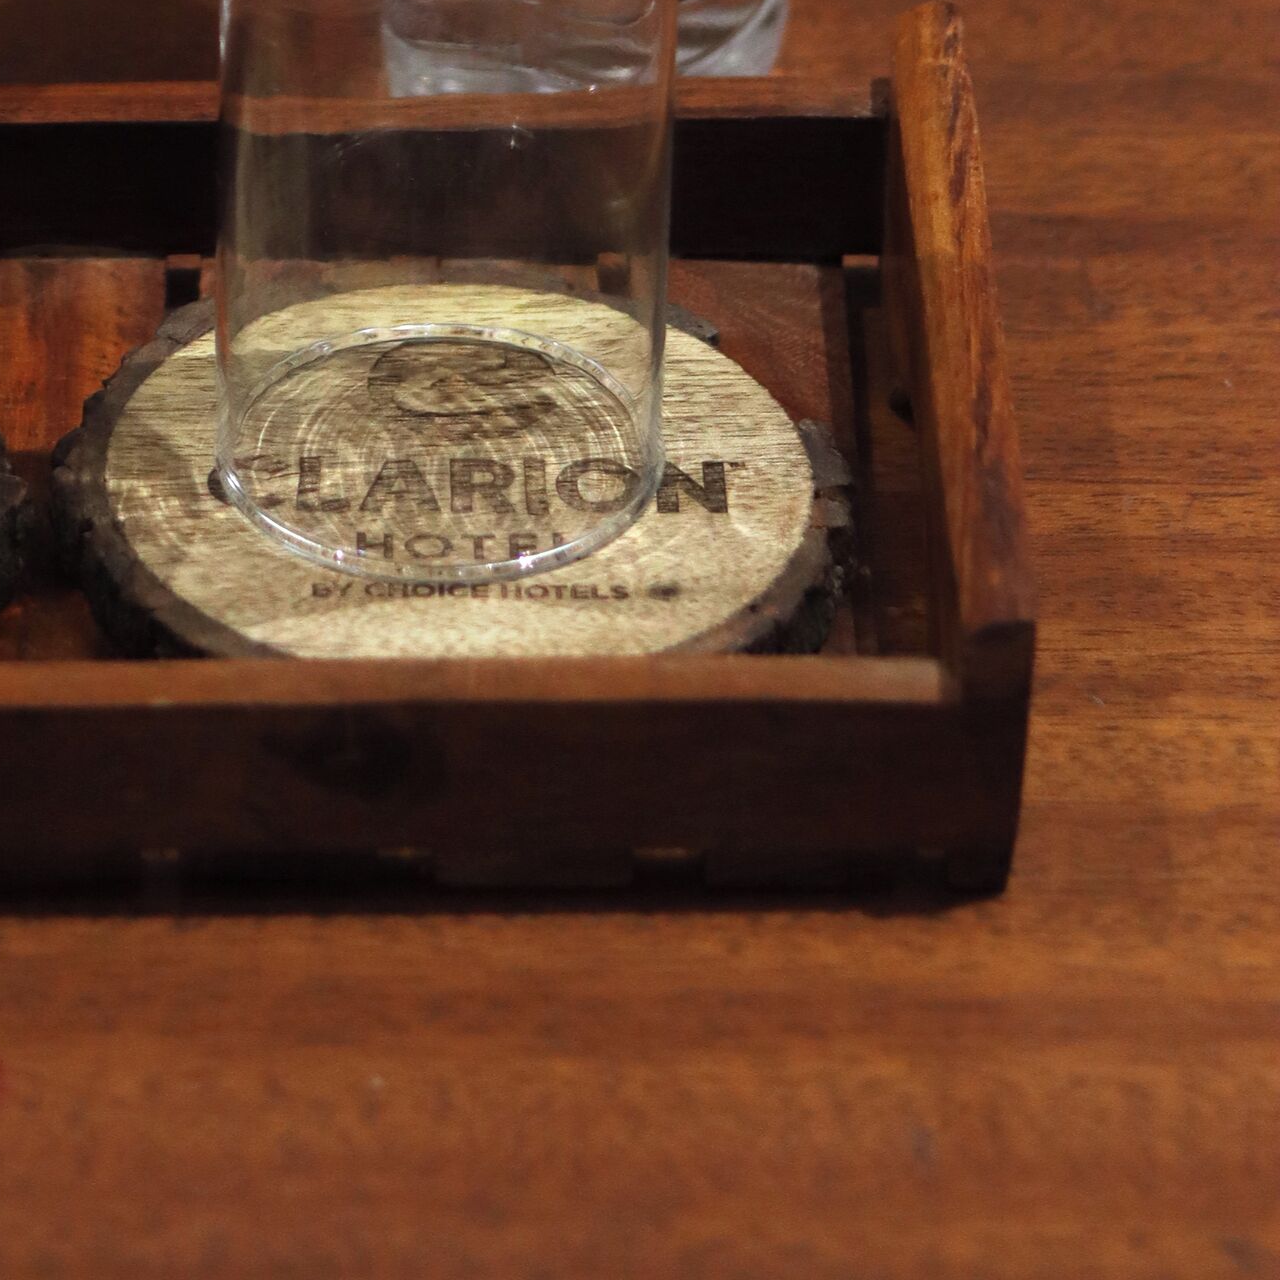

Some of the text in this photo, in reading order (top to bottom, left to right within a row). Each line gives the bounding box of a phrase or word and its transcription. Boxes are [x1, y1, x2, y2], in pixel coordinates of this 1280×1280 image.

[208, 455, 728, 514] CLARION
[312, 582, 630, 599] BY CHOICE HOTELS
